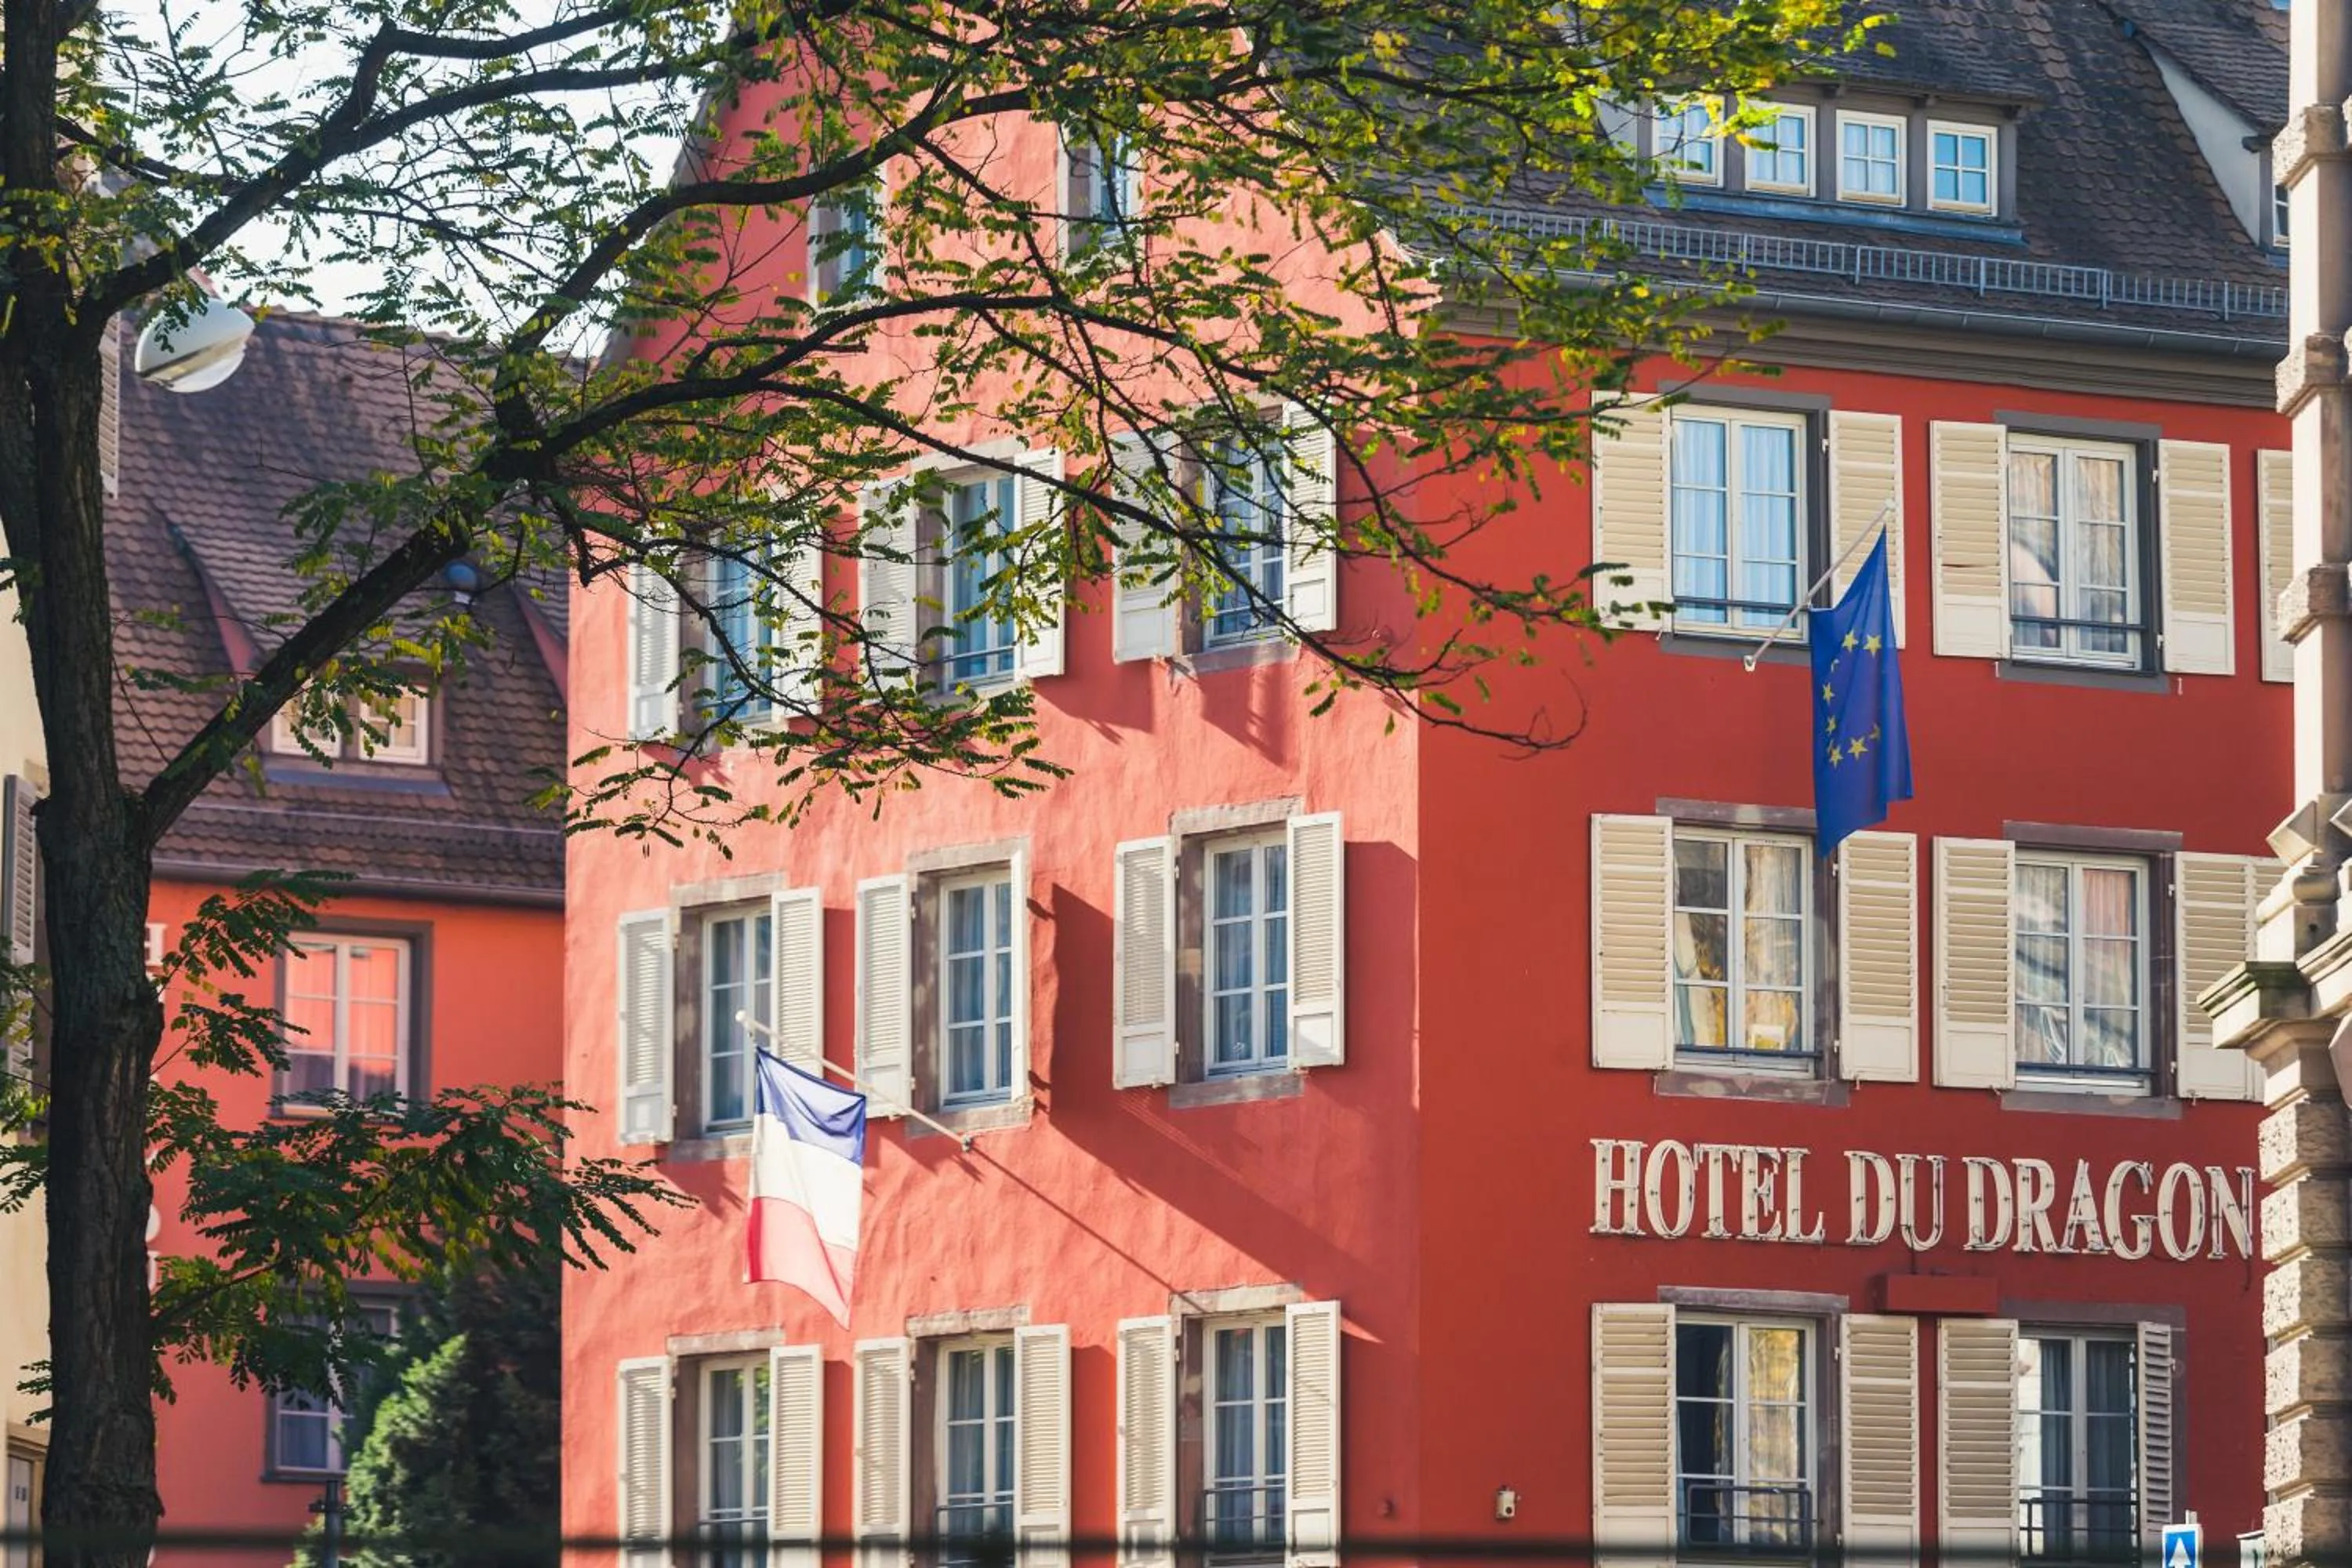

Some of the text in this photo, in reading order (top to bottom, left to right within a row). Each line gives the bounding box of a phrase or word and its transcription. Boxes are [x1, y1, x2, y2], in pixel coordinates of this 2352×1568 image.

[1589, 1138, 2256, 1261] HOTEL DU DRAGON
